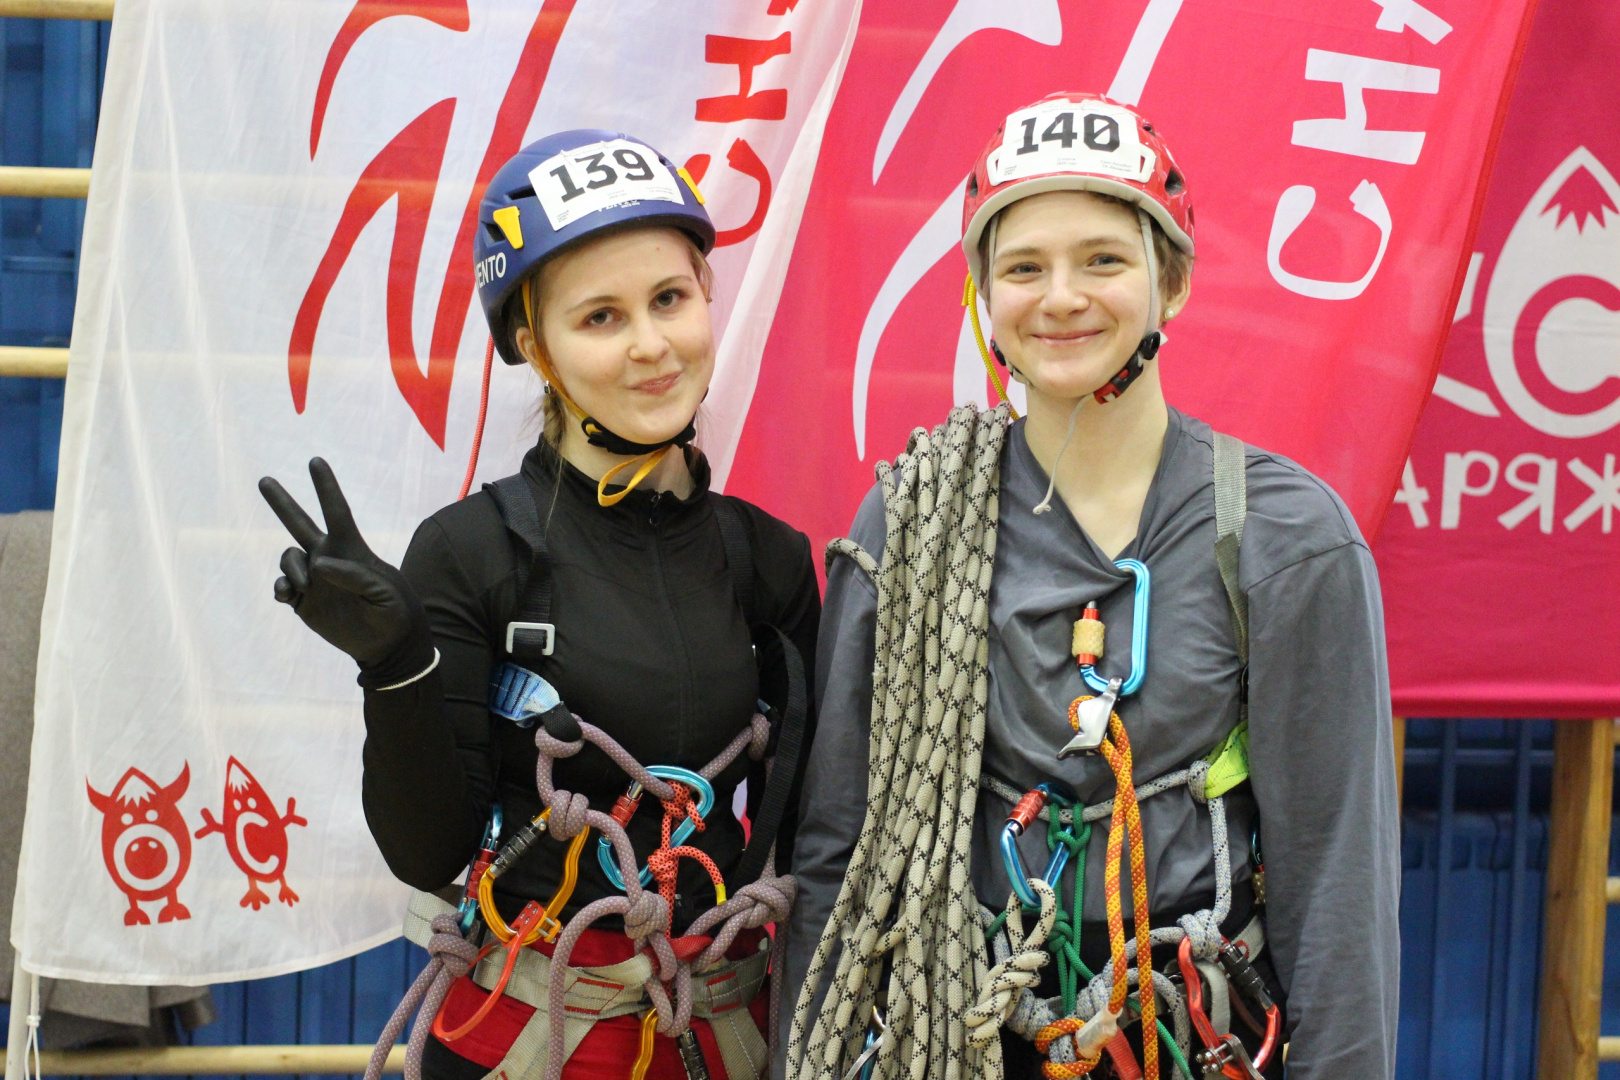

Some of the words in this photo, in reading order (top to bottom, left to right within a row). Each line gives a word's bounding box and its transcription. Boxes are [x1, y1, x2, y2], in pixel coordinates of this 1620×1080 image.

[684, 0, 798, 248] СН
[1017, 112, 1120, 155] 140
[550, 149, 655, 203] 139
